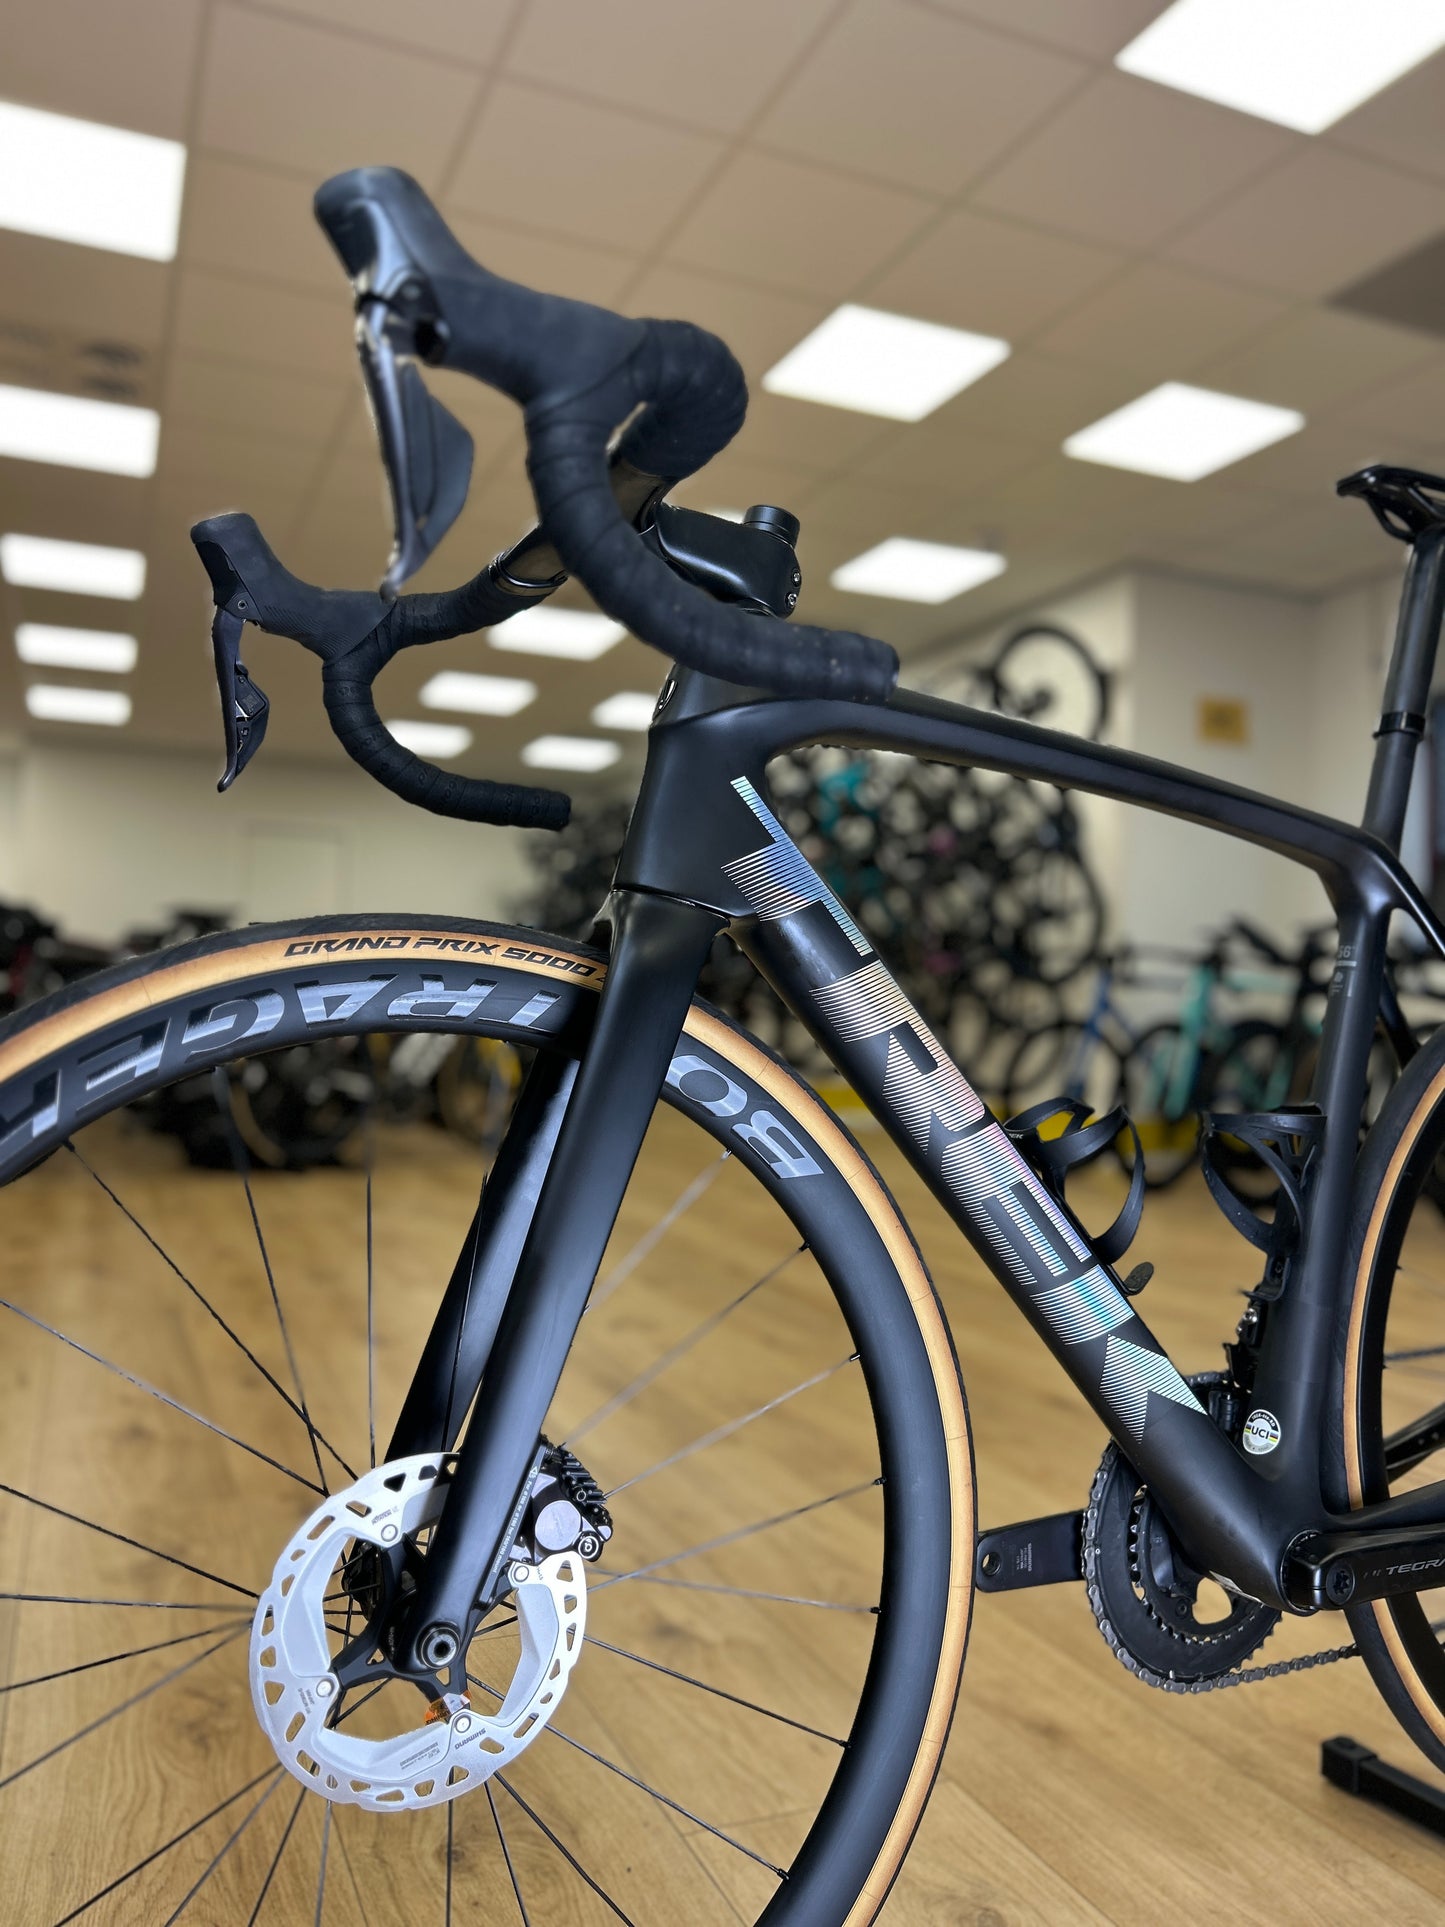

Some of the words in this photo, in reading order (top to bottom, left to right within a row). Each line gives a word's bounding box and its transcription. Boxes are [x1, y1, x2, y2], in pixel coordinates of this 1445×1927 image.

[284, 936, 411, 957] GRAND
[412, 936, 501, 956] PRIX
[501, 946, 598, 977] 5000
[720, 775, 1208, 1445] TREK
[1251, 1425, 1270, 1440] UCI
[454, 1727, 487, 1750] SHIMANO
